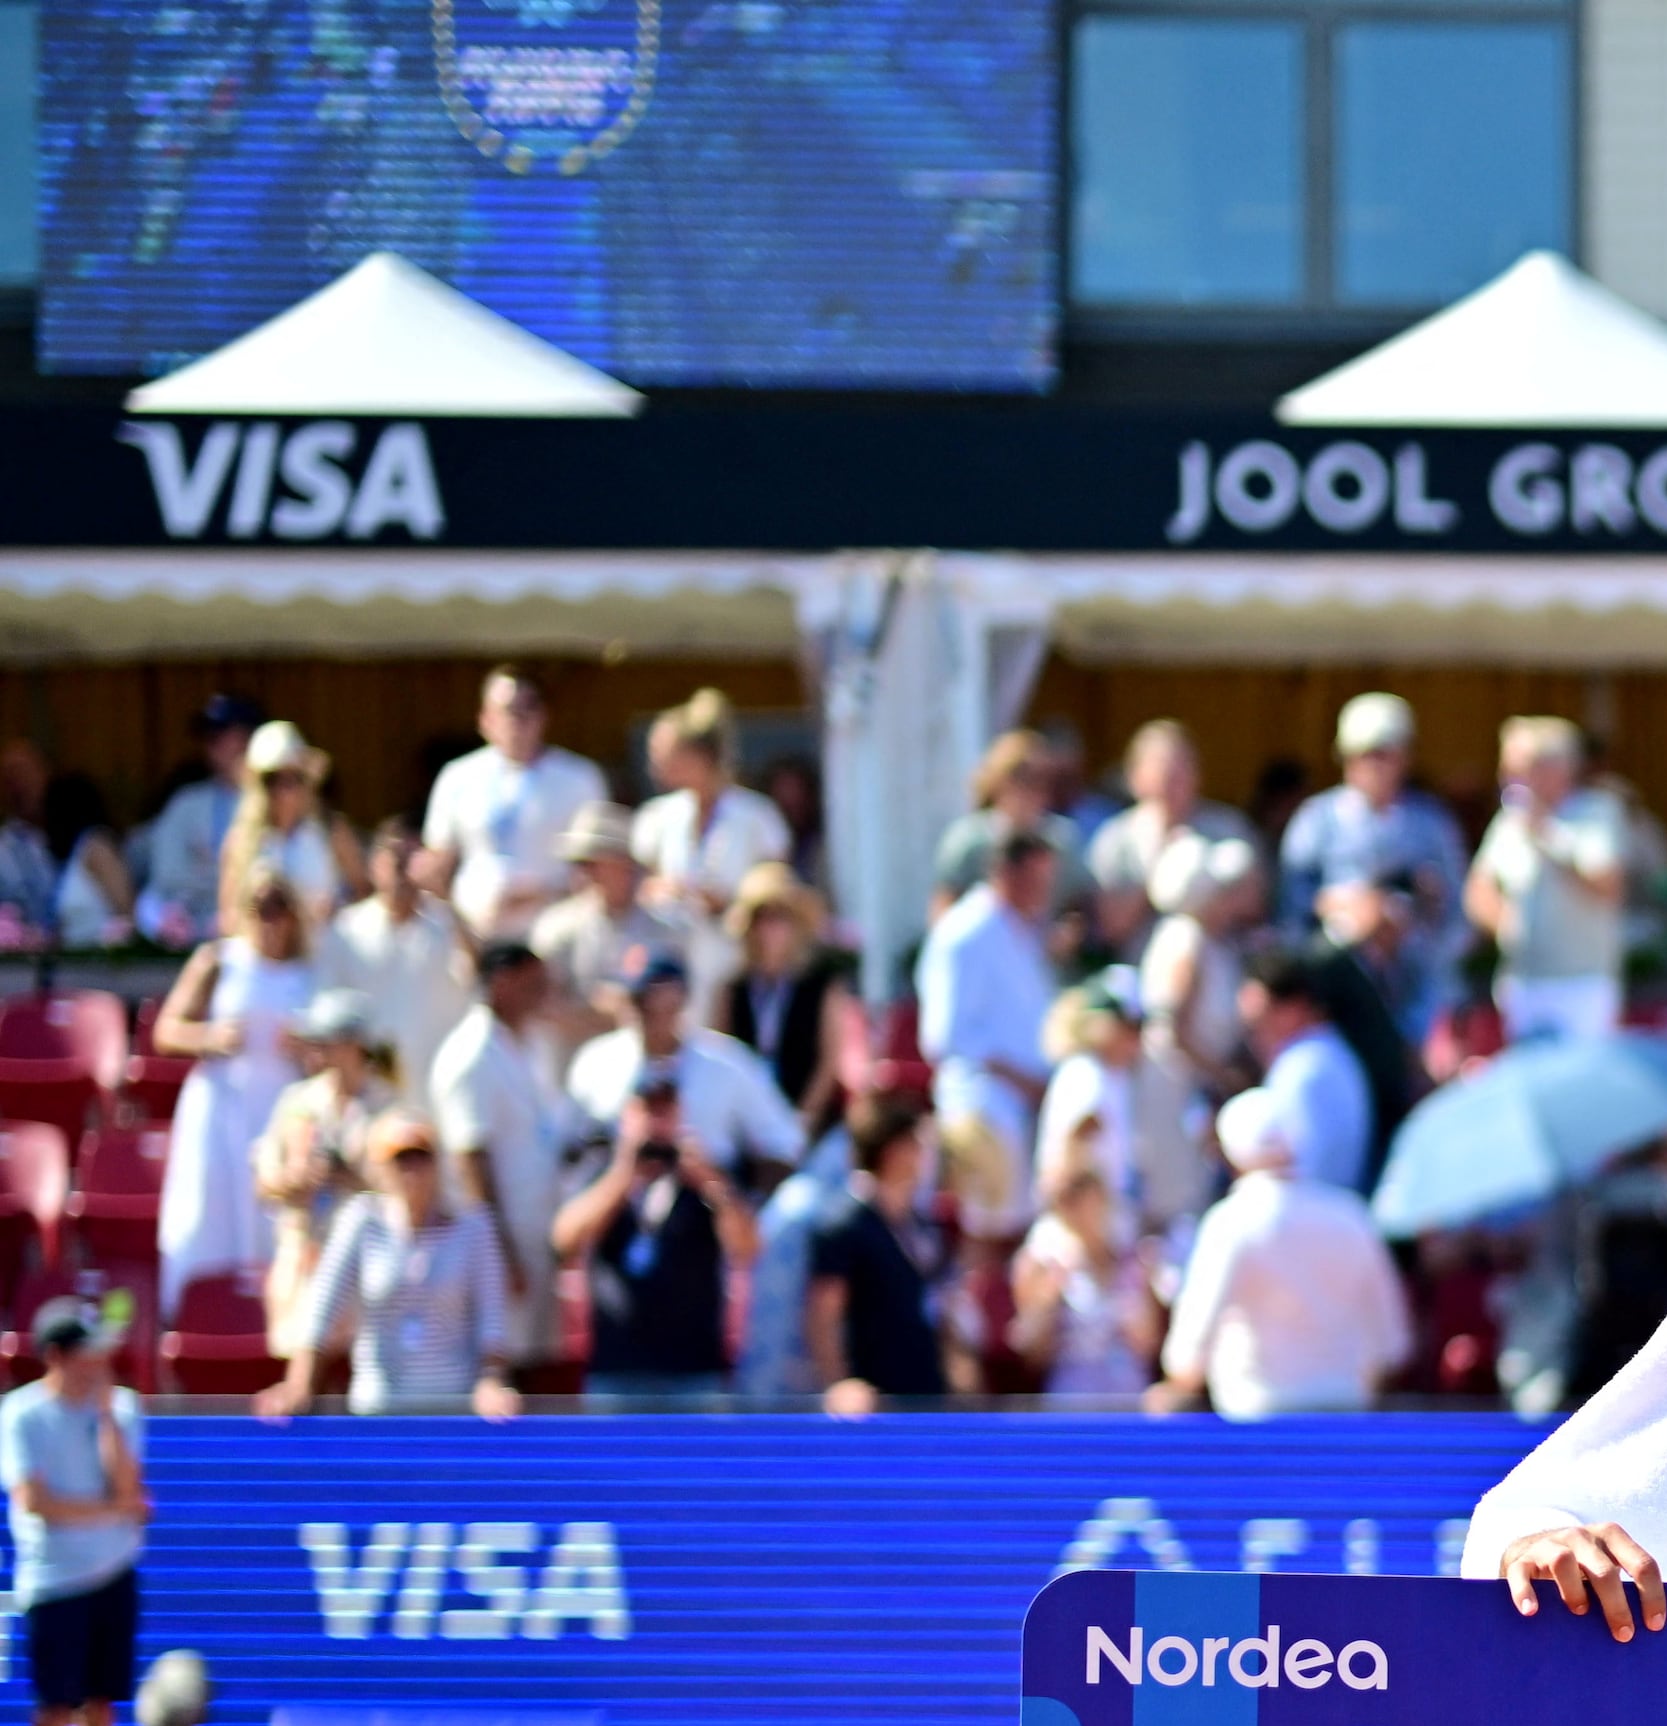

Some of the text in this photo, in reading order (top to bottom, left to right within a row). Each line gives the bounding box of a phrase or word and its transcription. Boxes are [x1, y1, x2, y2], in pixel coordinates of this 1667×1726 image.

[122, 421, 445, 540] VISA
[1167, 440, 1458, 544] JOOL
[299, 1520, 634, 1641] VISA
[1086, 1624, 1389, 1691] Nordea
